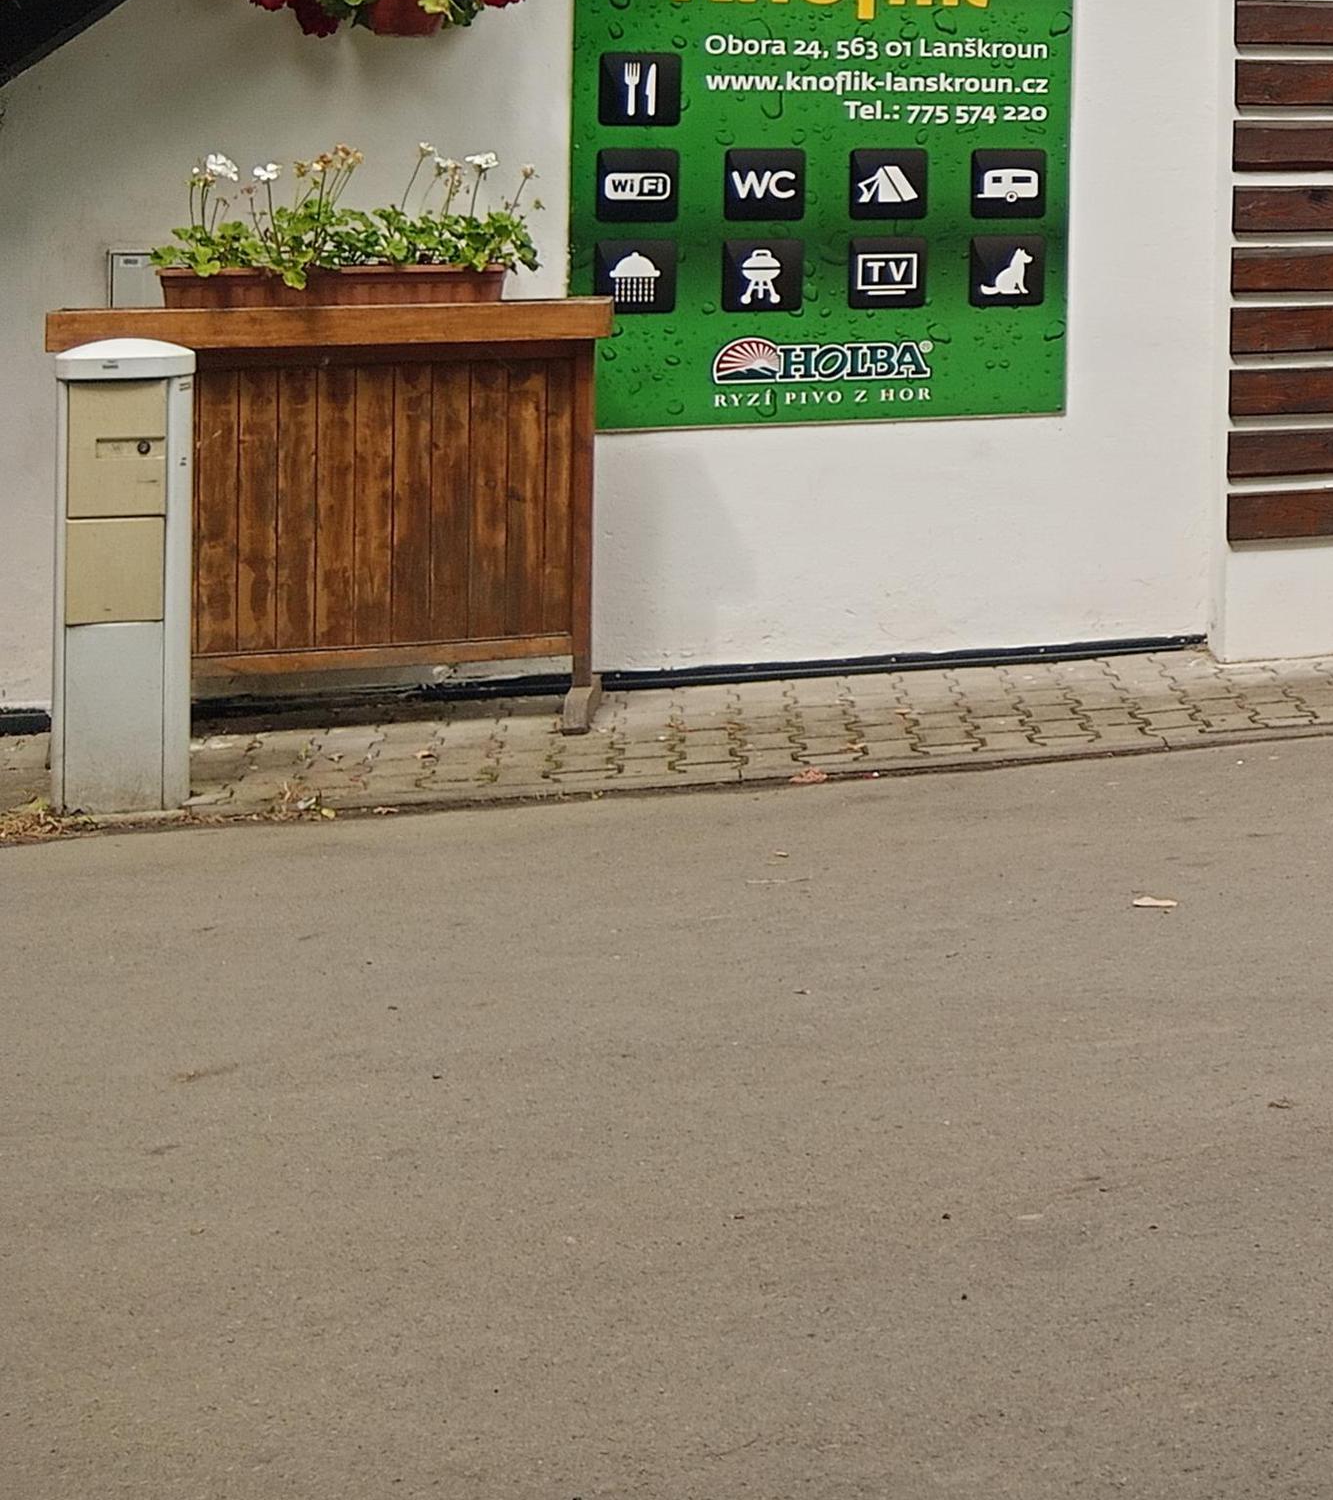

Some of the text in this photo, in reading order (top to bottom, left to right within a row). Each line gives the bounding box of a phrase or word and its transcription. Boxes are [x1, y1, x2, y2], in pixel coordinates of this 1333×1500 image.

[705, 35, 1048, 60] Obora 24, 563 01 Lanškroun
[706, 71, 1049, 96] www.knoflik-lanskroun.cz
[844, 100, 1048, 125] Tel.: 775 574 220
[732, 170, 796, 199] WC
[866, 260, 908, 282] TV
[776, 341, 932, 382] HOLBA
[714, 387, 931, 408] RYZÍ PIVO Z HOR
